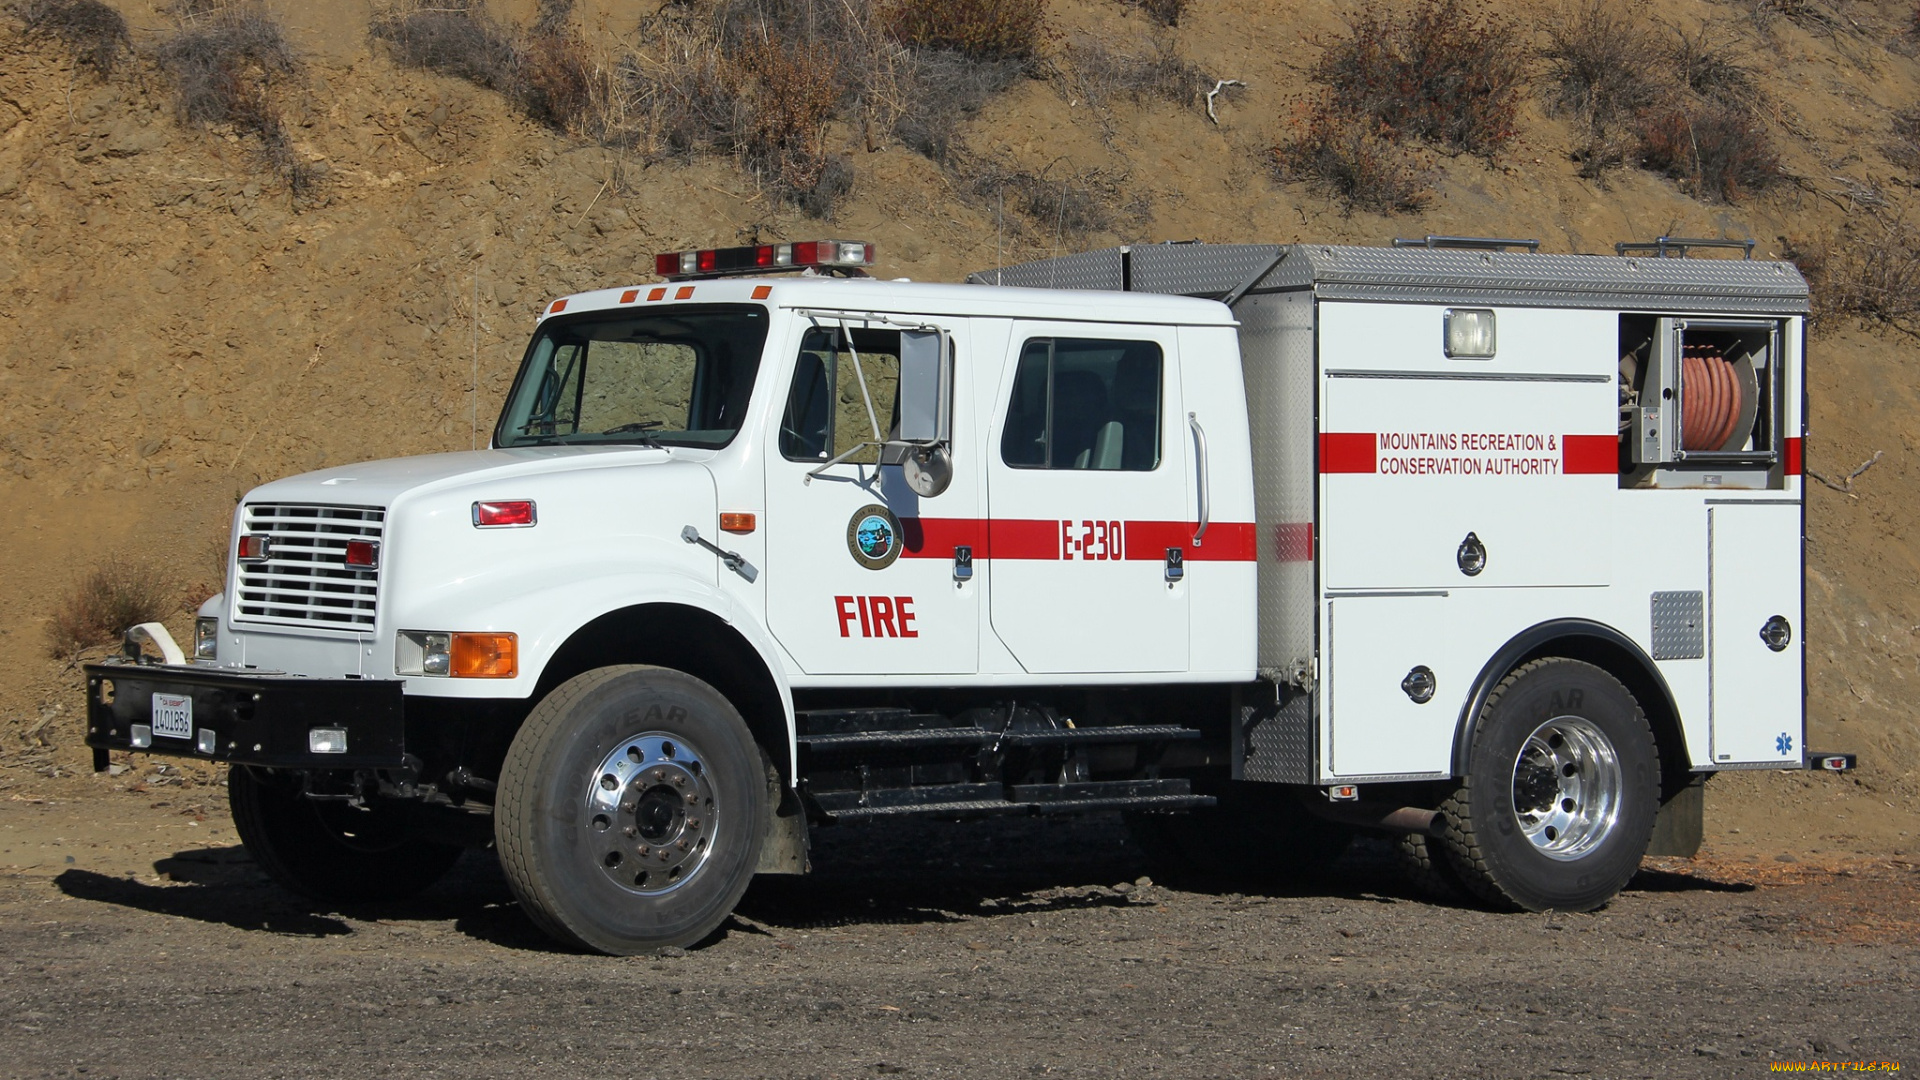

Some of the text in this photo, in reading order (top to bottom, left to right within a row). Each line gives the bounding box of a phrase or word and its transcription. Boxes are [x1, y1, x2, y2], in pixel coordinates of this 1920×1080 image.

[1380, 433, 1557, 451] MOUNTAINS RECREATION &
[1380, 457, 1559, 475] CONSERVATION AUTHORITY
[1062, 520, 1122, 560] E-230
[834, 595, 919, 638] FIRE
